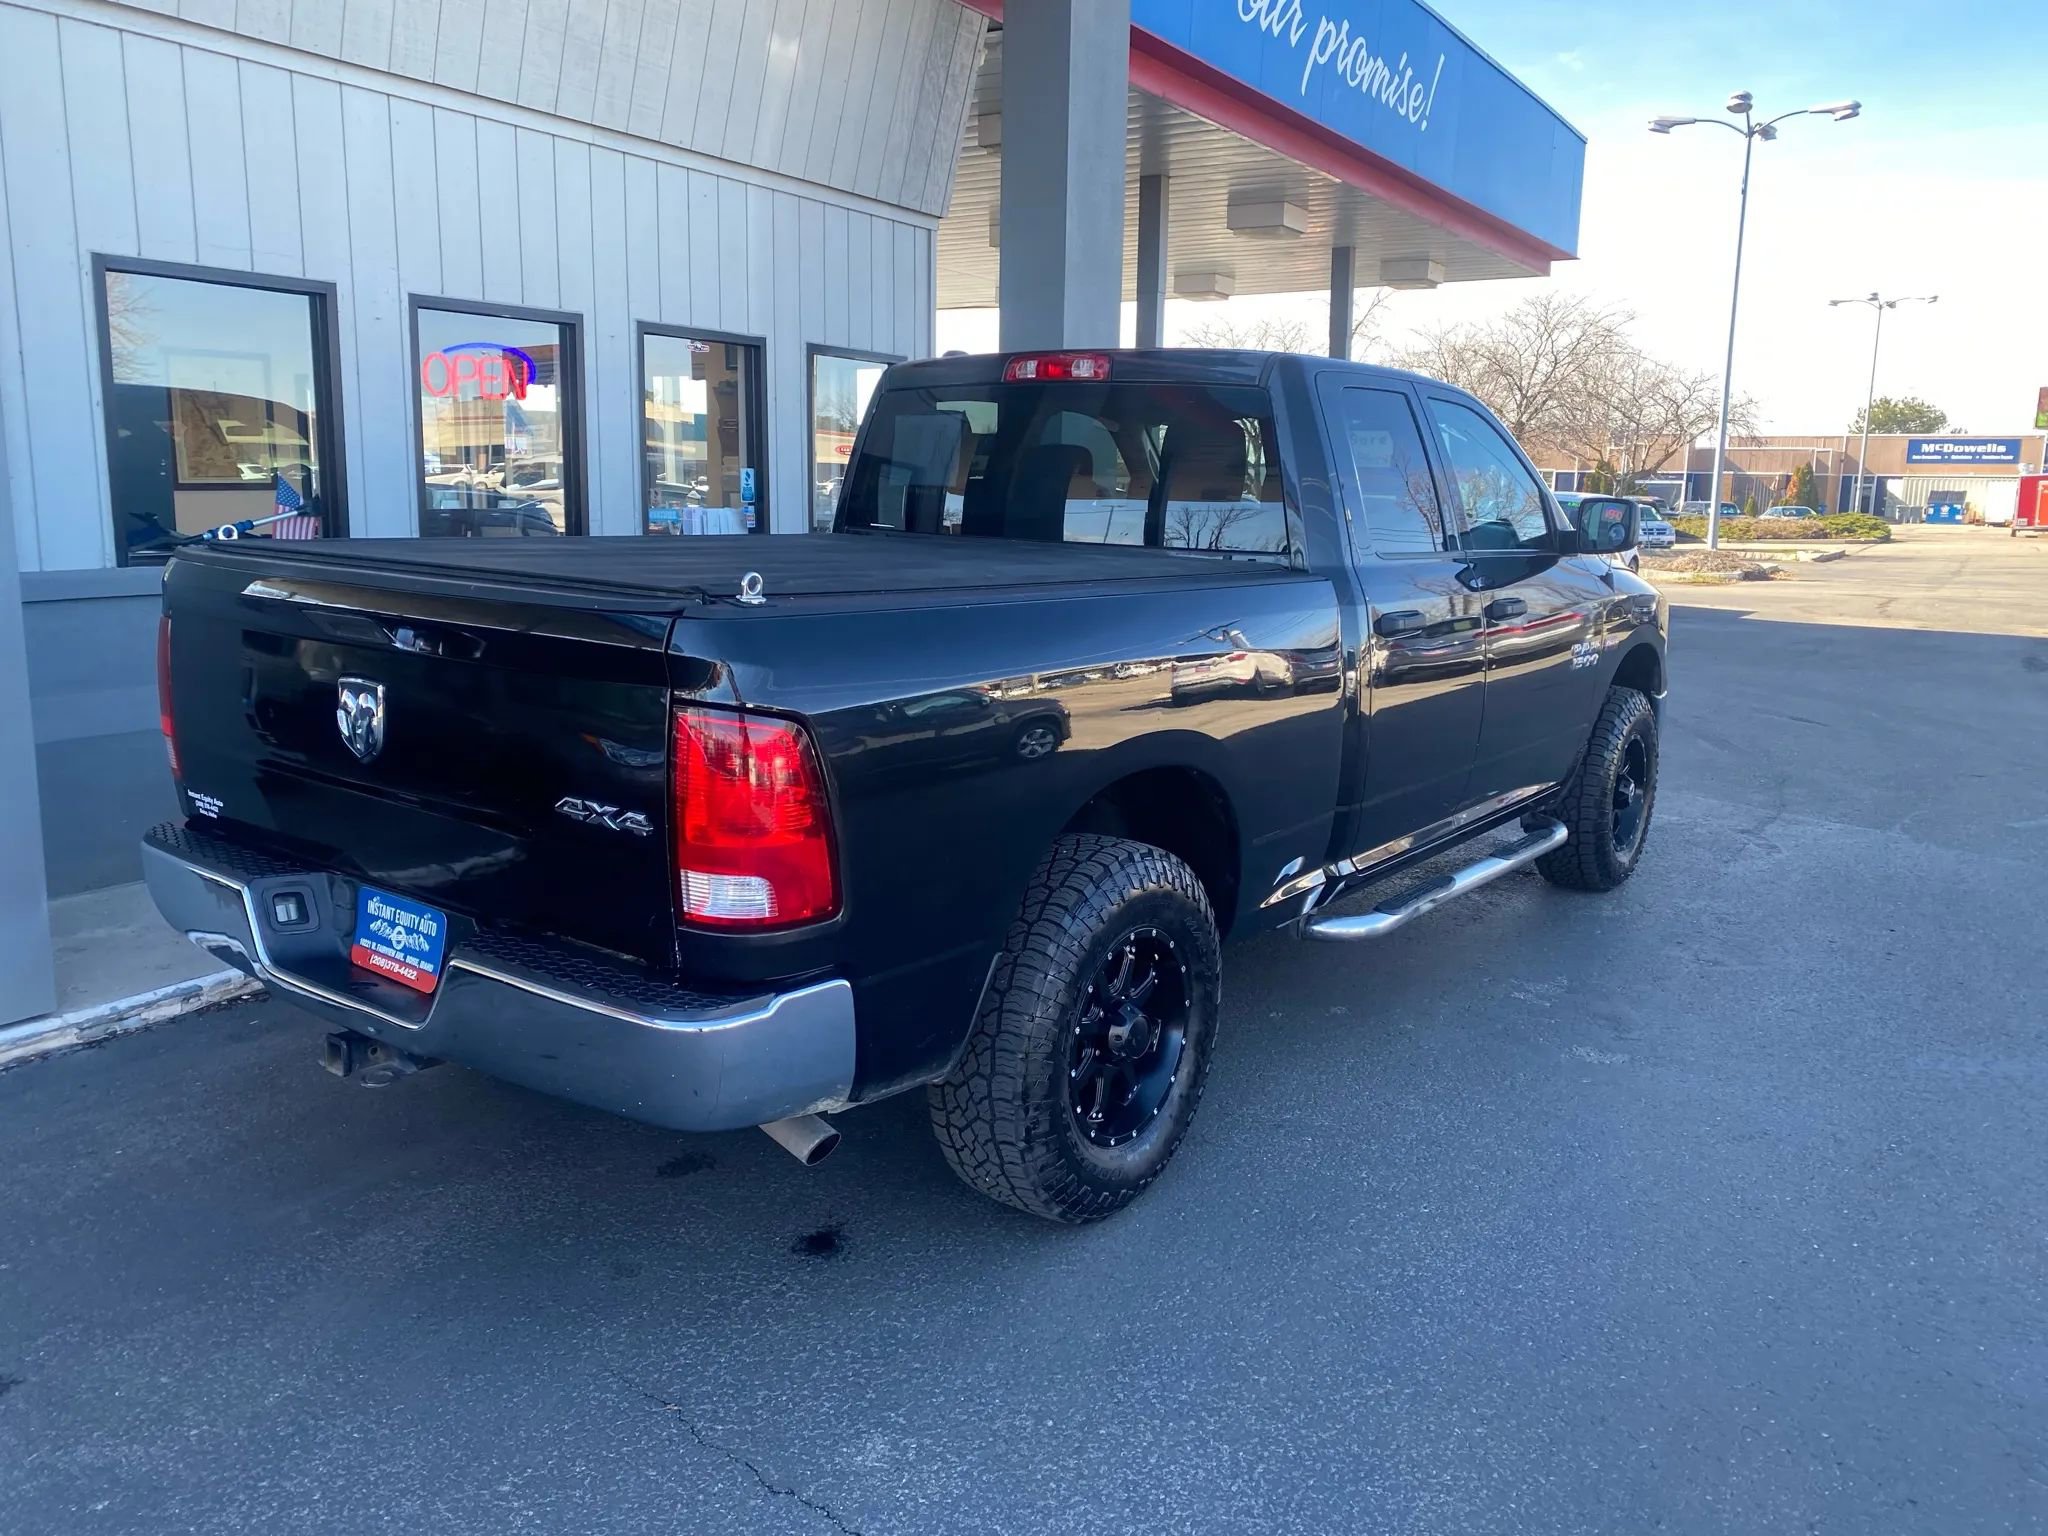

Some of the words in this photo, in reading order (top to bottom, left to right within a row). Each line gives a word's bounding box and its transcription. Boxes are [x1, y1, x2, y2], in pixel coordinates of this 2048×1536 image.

[1301, 16, 1445, 131] promise!
[422, 351, 528, 400] OPEN
[1921, 443, 2006, 453] McDowells
[367, 900, 395, 921] INSTANT
[395, 910, 420, 932] EQUITY
[418, 918, 437, 936] AUTO
